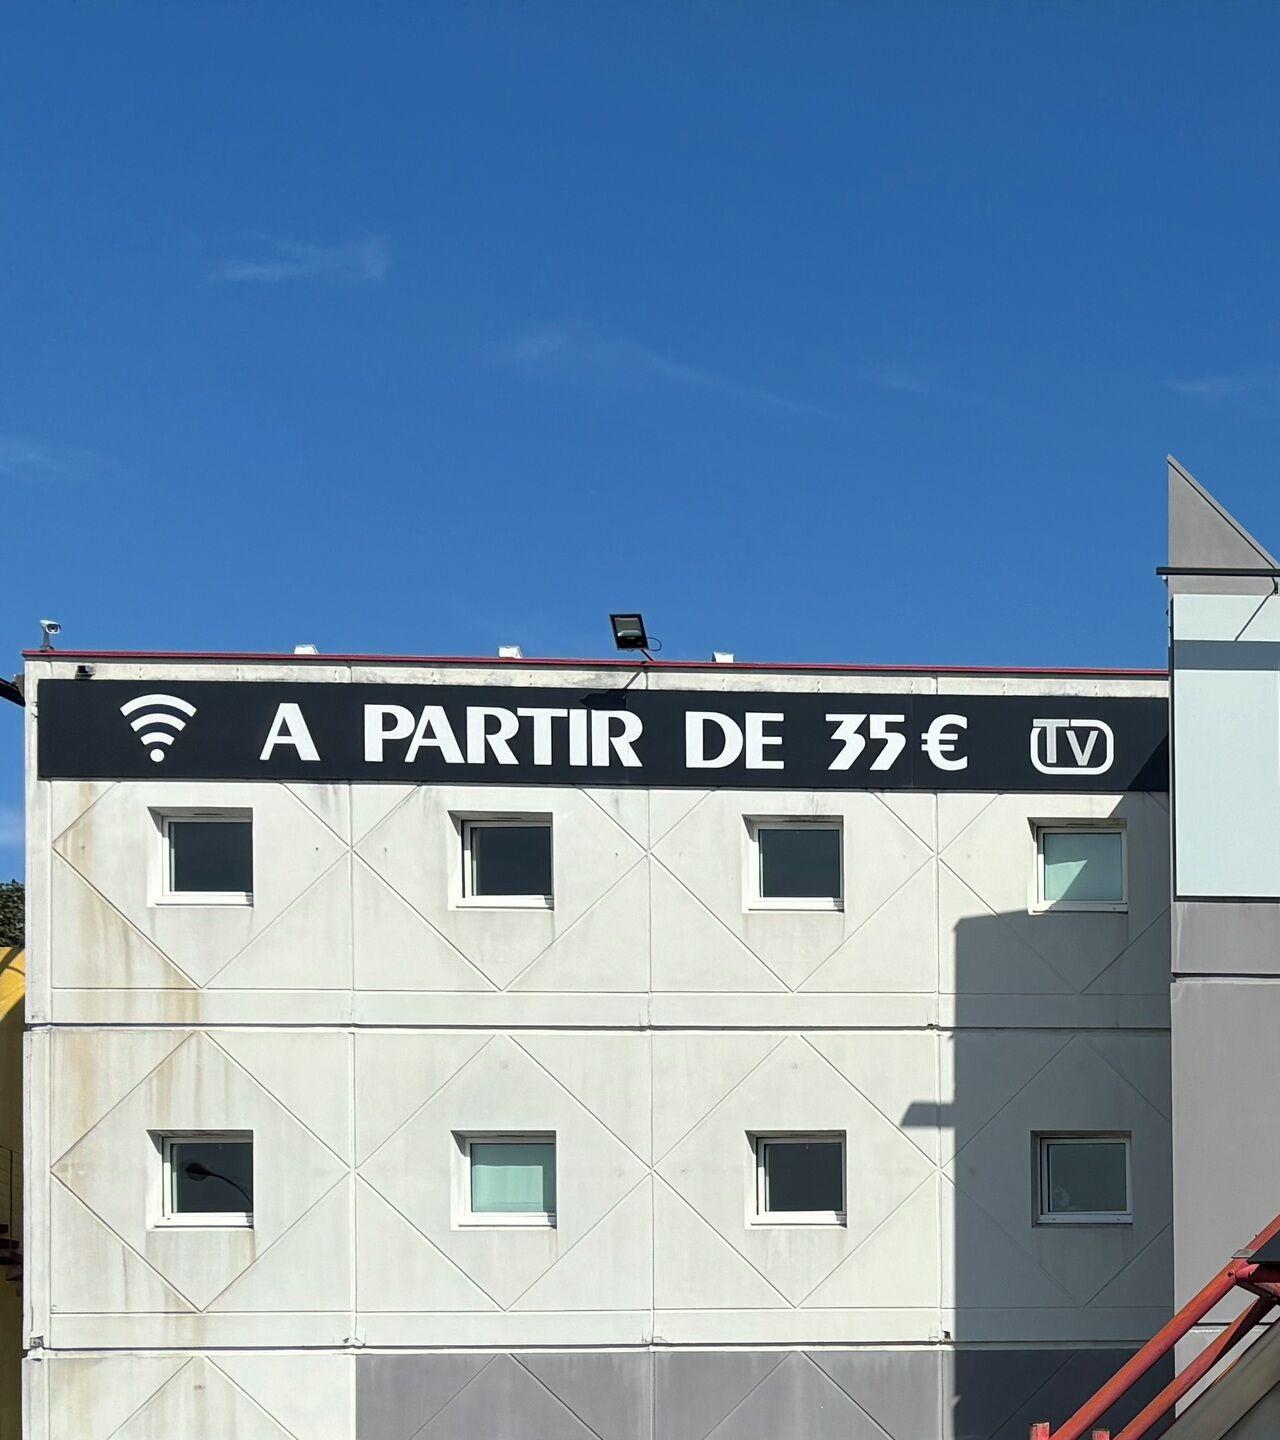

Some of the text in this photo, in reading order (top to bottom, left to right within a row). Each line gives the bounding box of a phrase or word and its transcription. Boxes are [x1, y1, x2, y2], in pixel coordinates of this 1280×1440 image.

[259, 702, 320, 761] A
[364, 704, 643, 768] PARTIR
[685, 710, 785, 770] DE
[1032, 718, 1099, 767] TV
